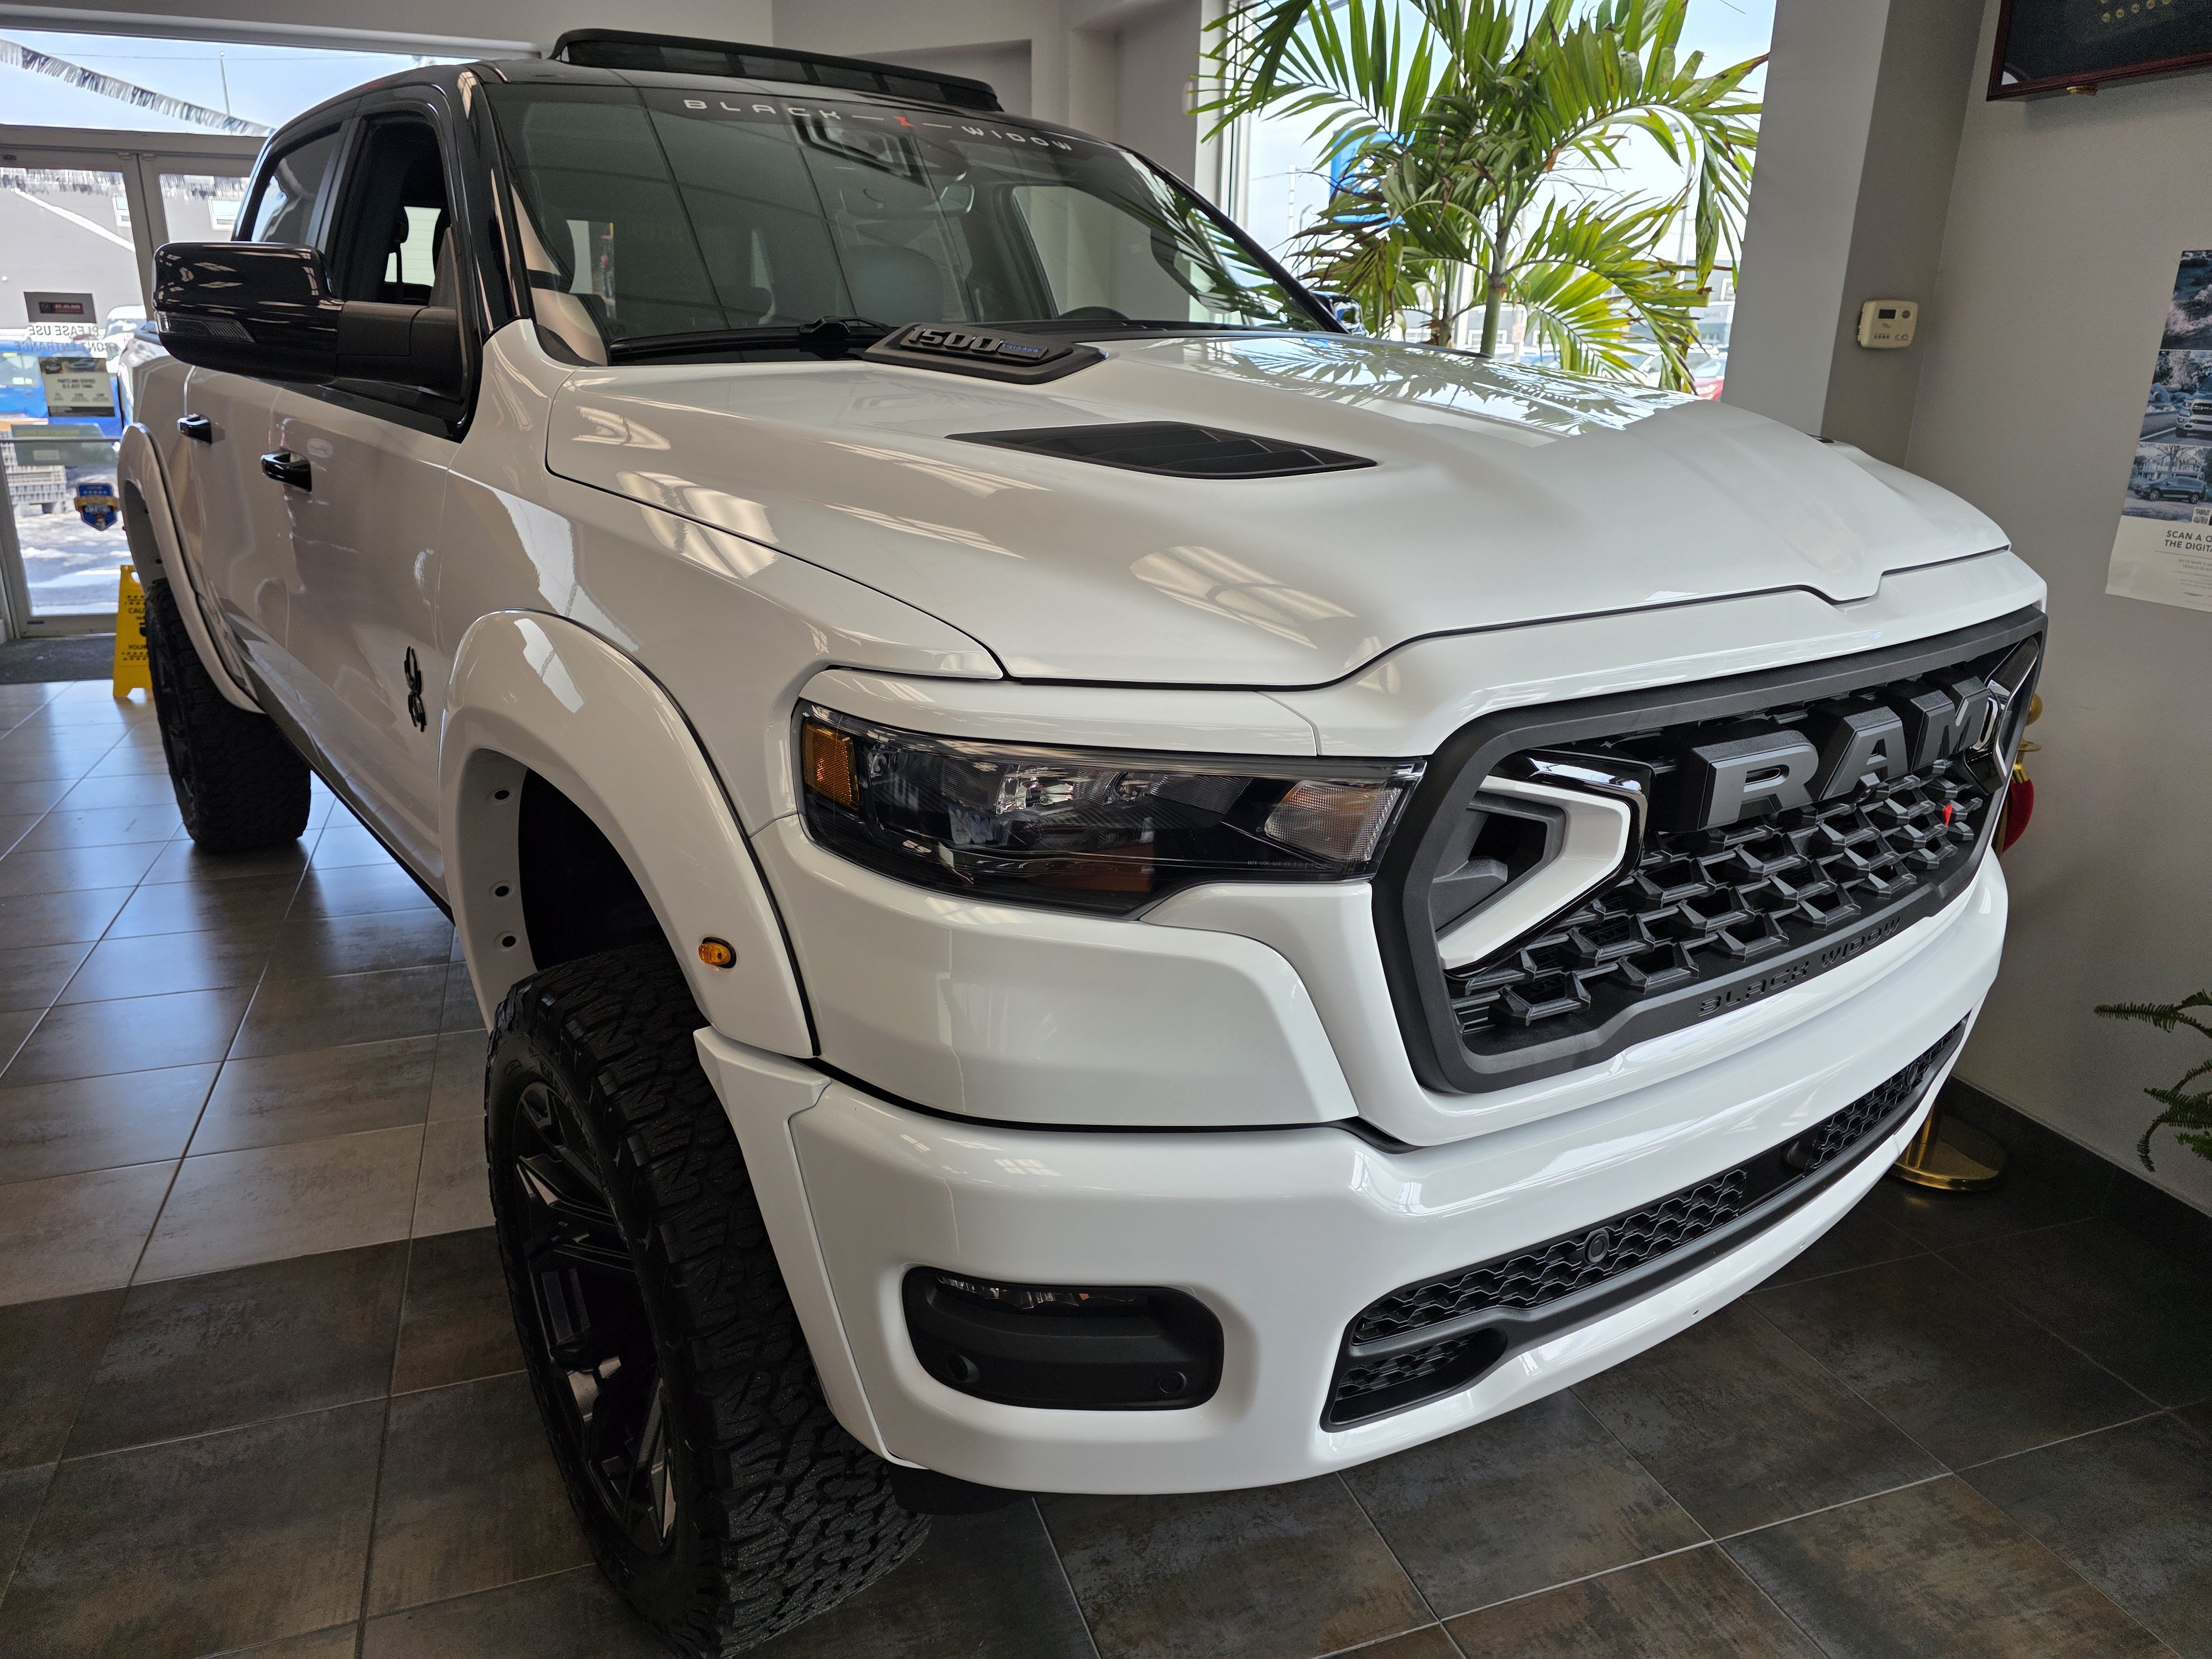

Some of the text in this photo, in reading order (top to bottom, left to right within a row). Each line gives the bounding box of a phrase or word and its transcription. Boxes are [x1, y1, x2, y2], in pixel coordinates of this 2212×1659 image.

[683, 99, 1072, 150] BLACK WIDOW
[907, 326, 1003, 354] 1500
[2164, 539, 2183, 548] THE
[2166, 530, 2193, 540] SCAN
[1695, 680, 1990, 831] RAM
[1698, 916, 1901, 1017] BLACK WIDOW
